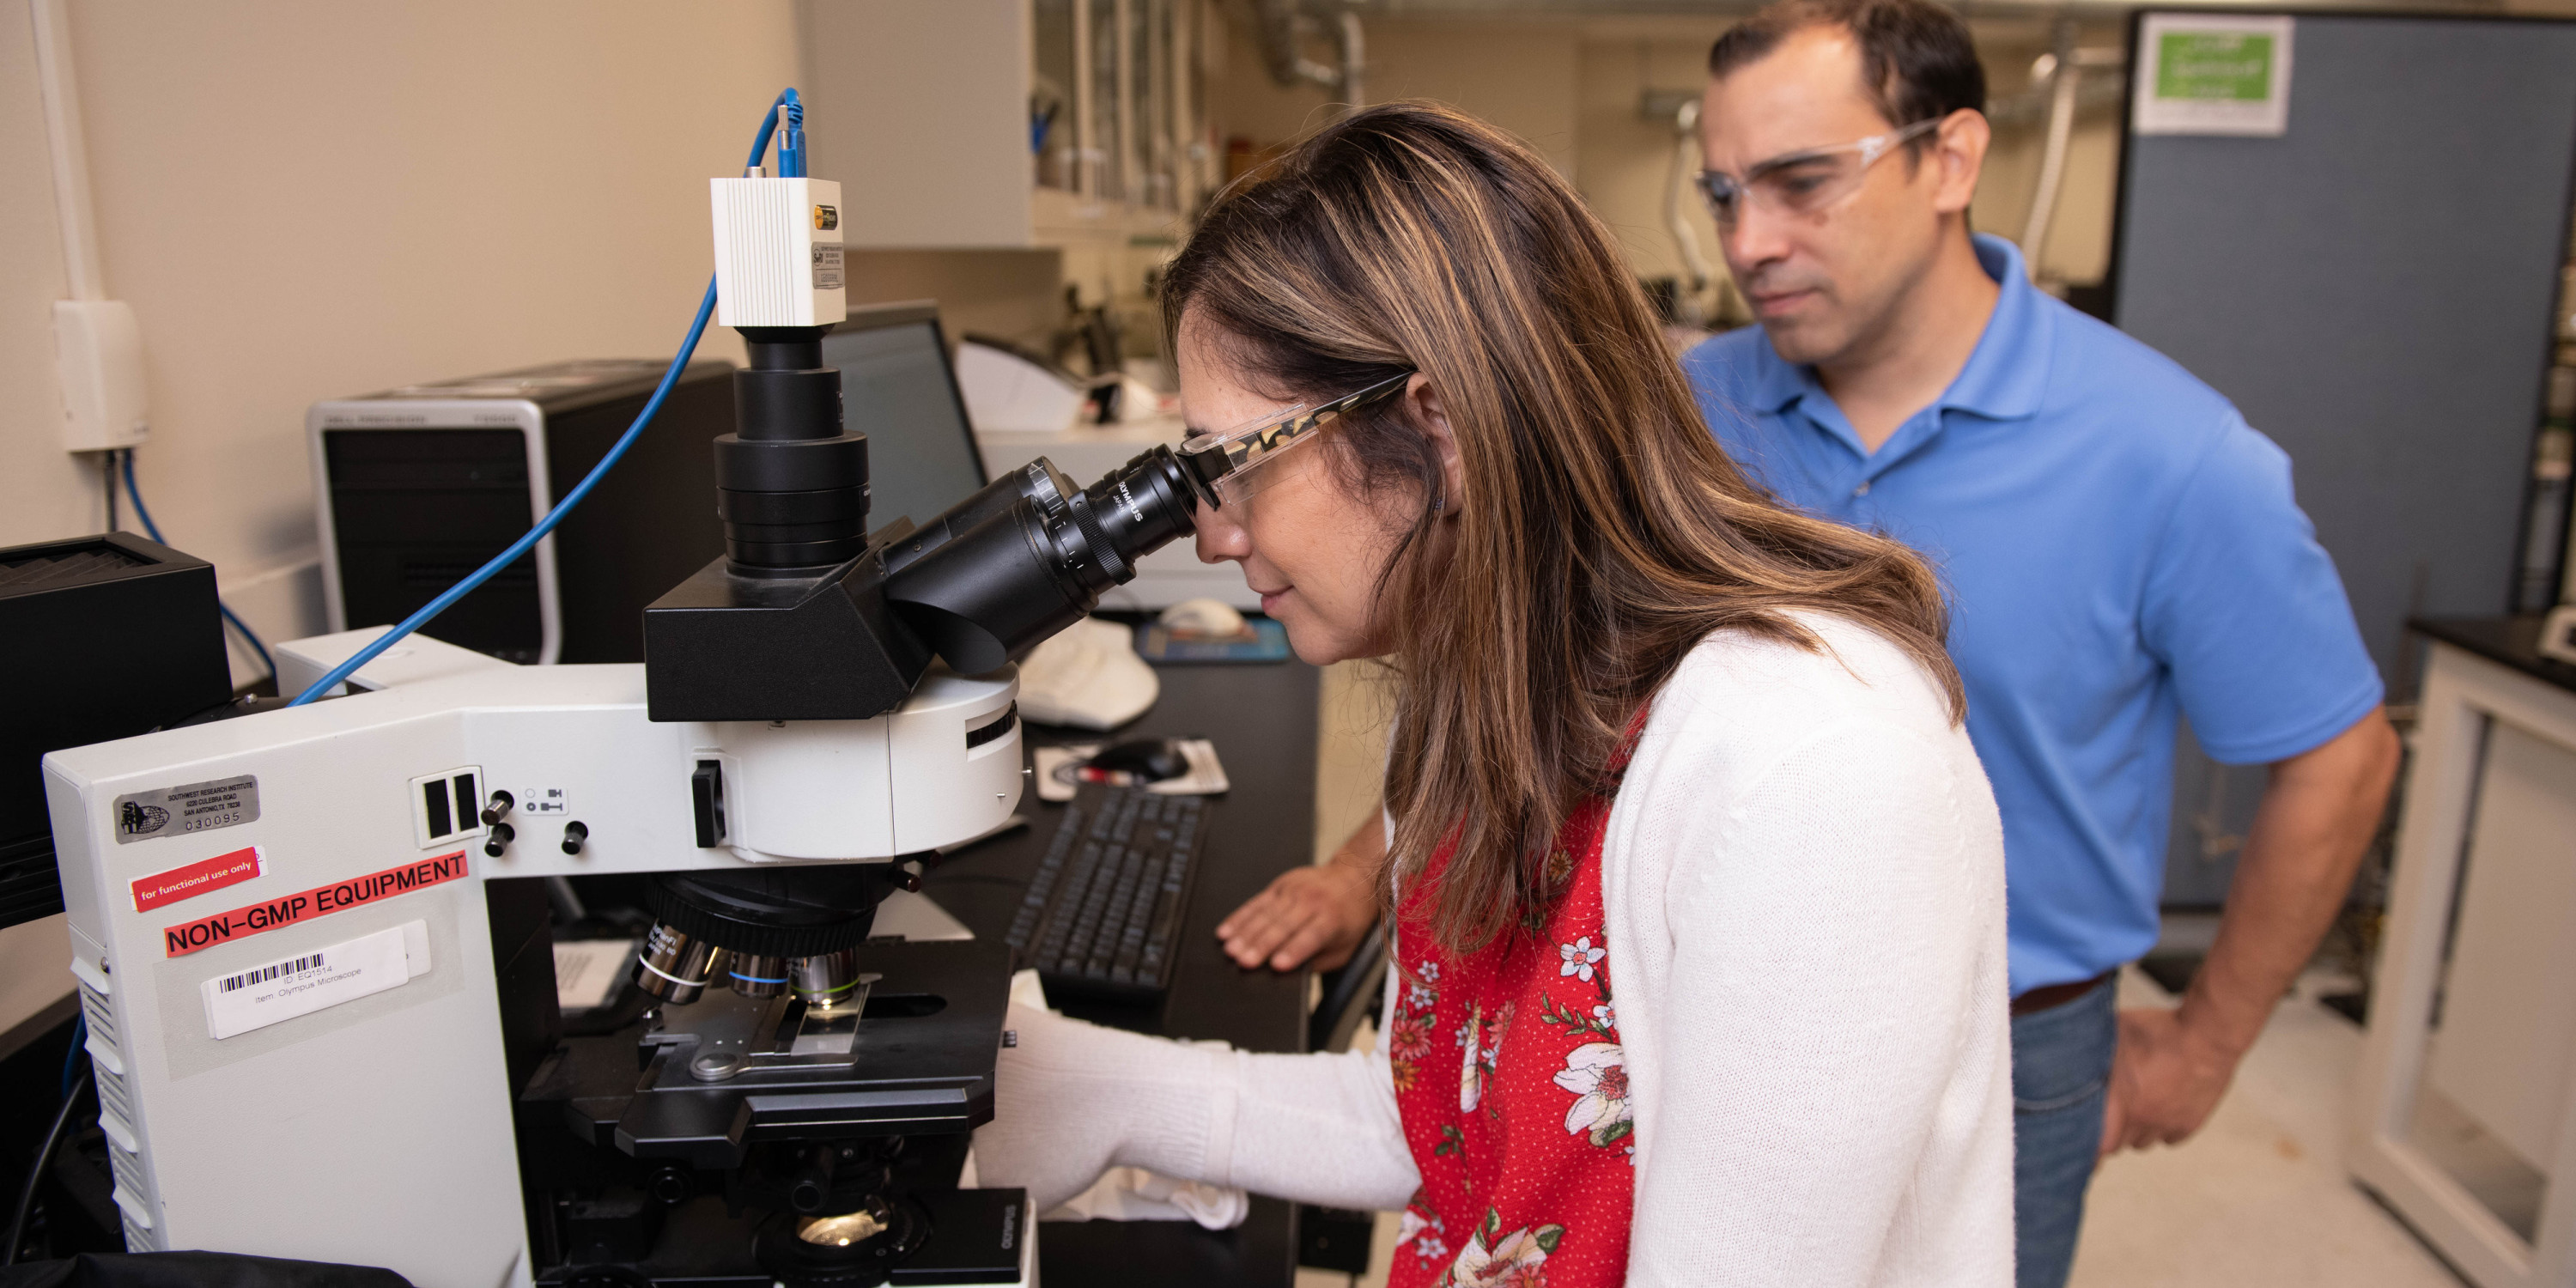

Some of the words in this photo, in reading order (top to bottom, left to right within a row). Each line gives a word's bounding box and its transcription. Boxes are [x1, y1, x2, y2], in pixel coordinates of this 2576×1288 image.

[1113, 495, 1126, 513] JAPAN
[1118, 481, 1143, 522] OLYMPUS
[167, 791, 199, 801] SOUTHWEST
[200, 786, 228, 795] RESEARCH
[228, 782, 253, 792] INSTITUTE
[198, 797, 222, 805] CULEBRA
[185, 812, 240, 830] 030095
[141, 890, 157, 901] for
[158, 873, 210, 896] functional
[211, 869, 228, 879] use
[230, 861, 252, 874] only
[167, 896, 307, 952] NON-GMP
[317, 854, 465, 912] EQUIPMENT
[278, 981, 315, 999] Olympus
[317, 968, 361, 987] Microscope
[298, 965, 332, 981] EQ1514
[1001, 1205, 1017, 1249] OLYMPUS
